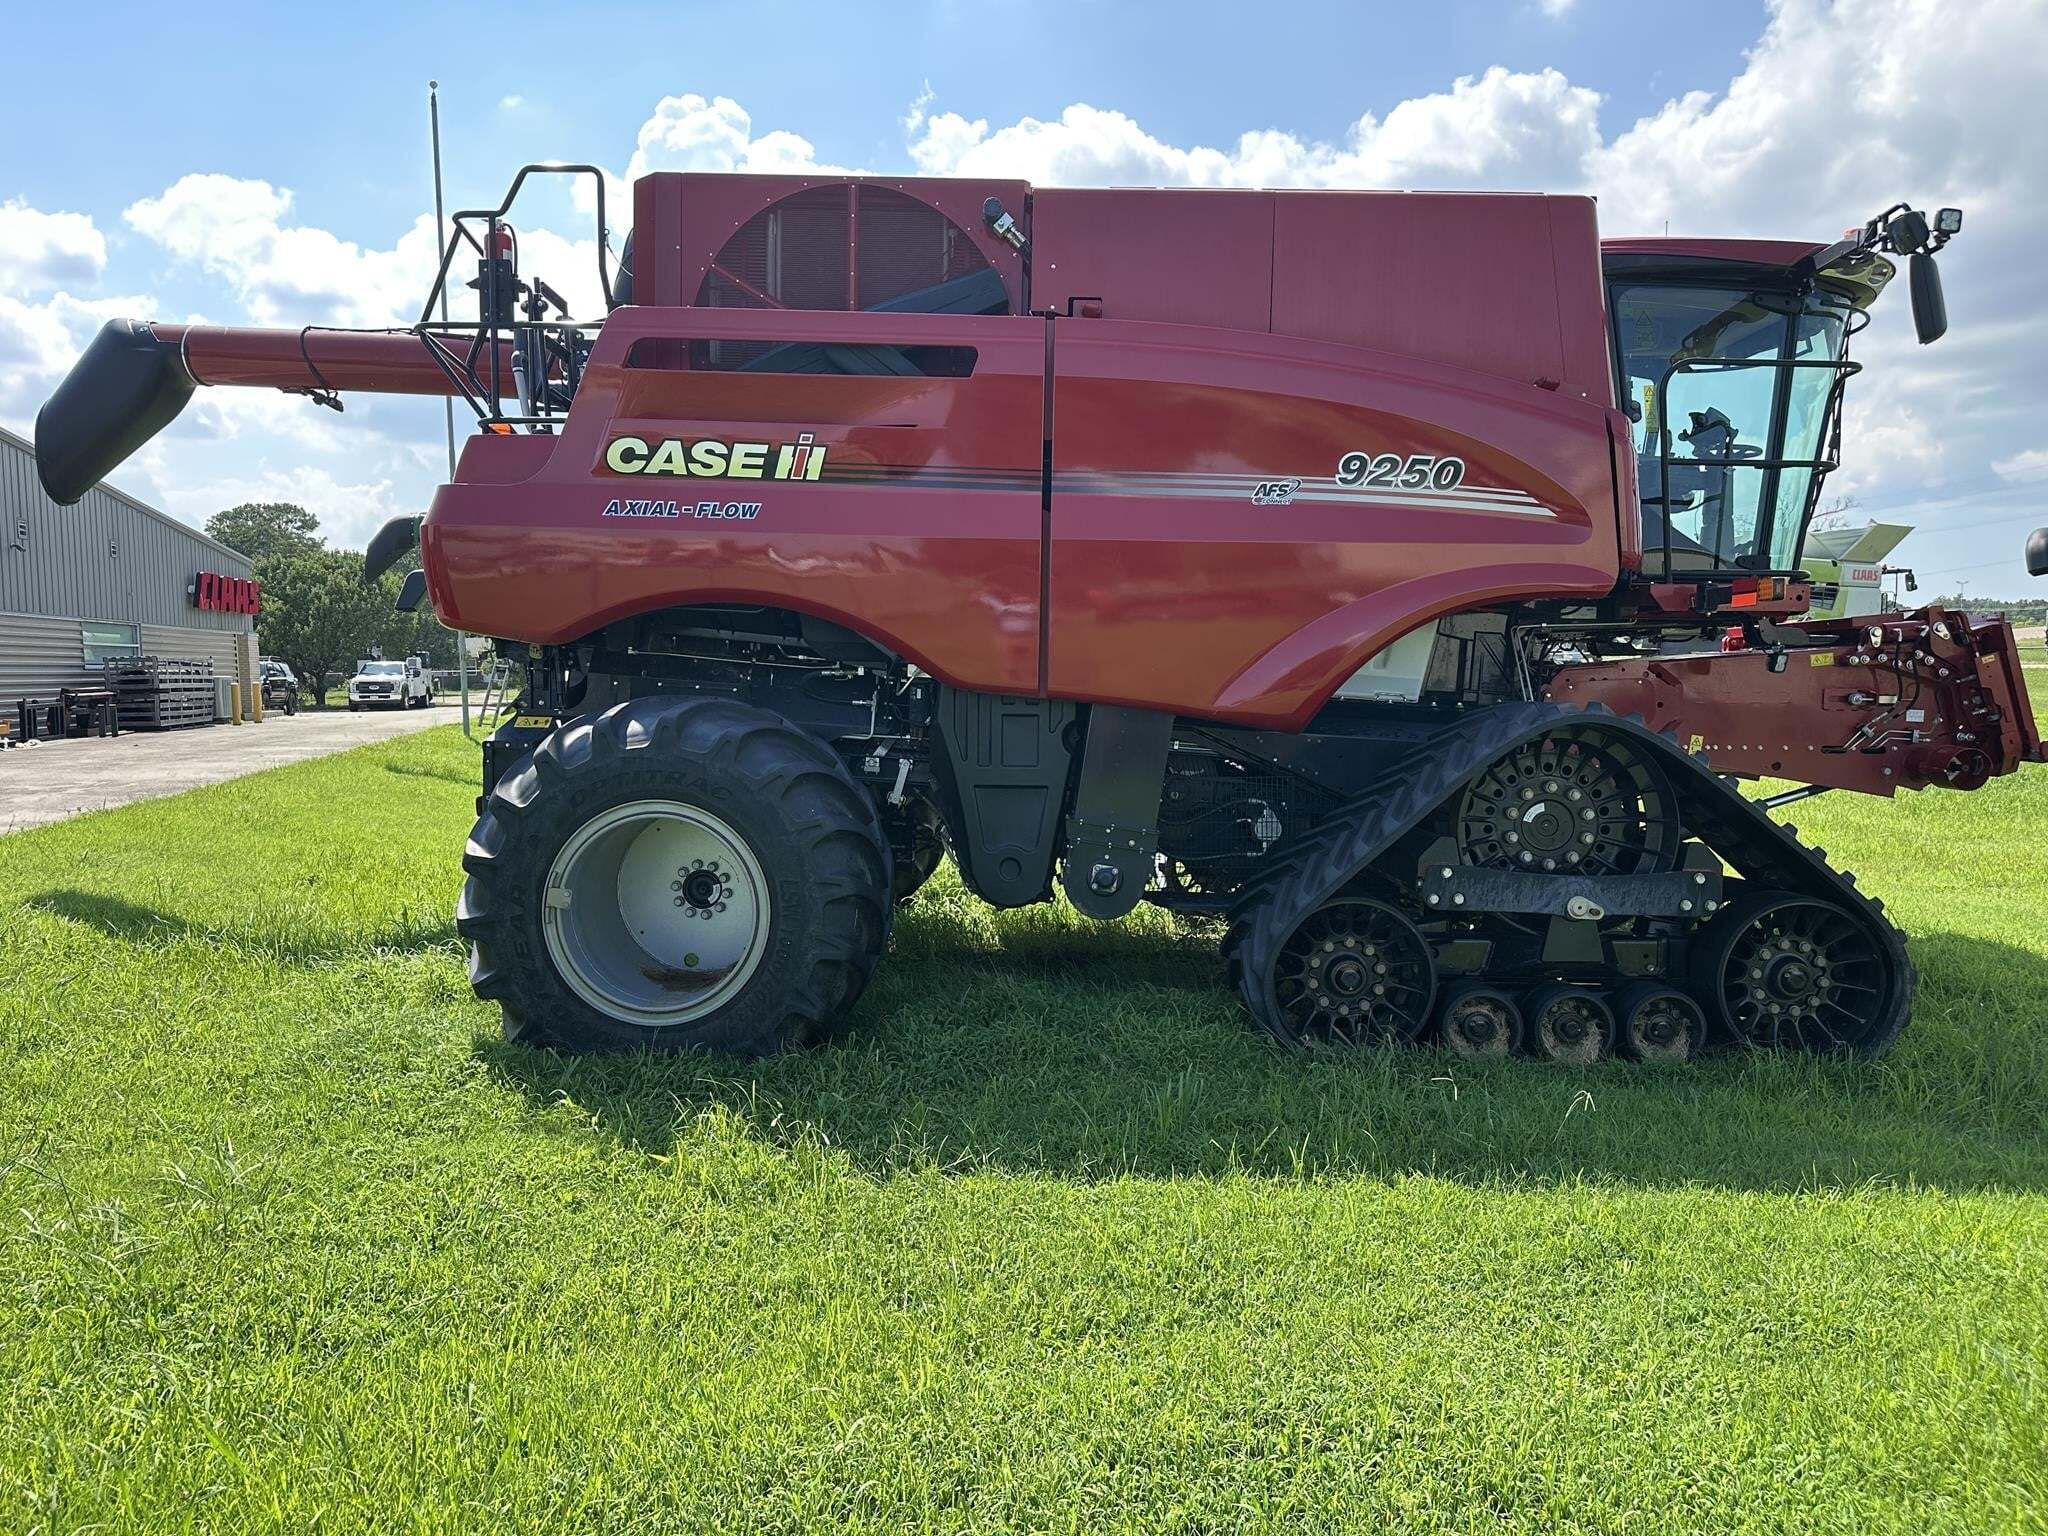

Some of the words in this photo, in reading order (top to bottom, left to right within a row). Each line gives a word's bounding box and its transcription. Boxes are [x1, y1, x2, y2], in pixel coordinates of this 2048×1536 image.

[605, 436, 770, 479] CASE
[1335, 451, 1466, 492] 9250
[1251, 481, 1293, 498] AFS
[602, 499, 763, 520] AXIAL-FLOW
[1852, 569, 1879, 581] CLAAS
[197, 571, 262, 616] CLAAS
